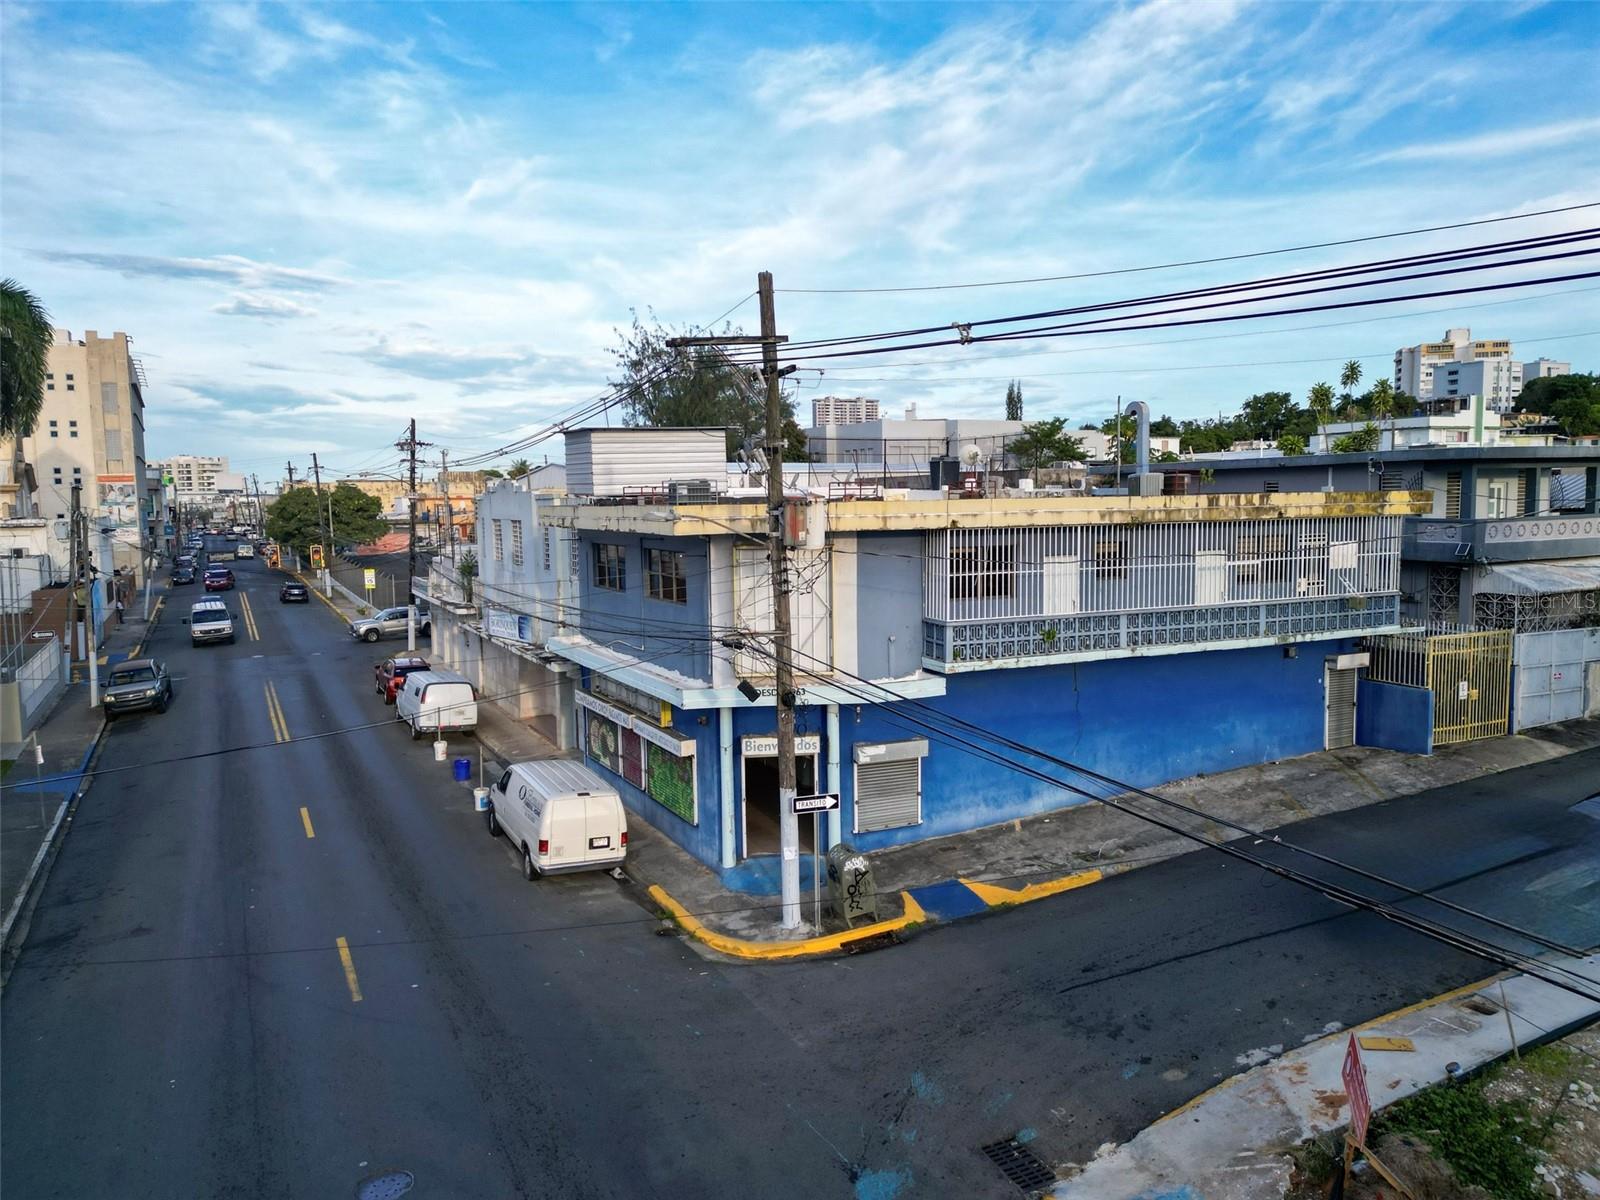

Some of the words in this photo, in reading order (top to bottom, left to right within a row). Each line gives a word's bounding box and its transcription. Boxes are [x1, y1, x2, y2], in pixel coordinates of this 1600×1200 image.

[756, 688, 778, 697] DESD
[744, 738, 818, 752] Bienvdos
[797, 799, 827, 808] TRANSITO
